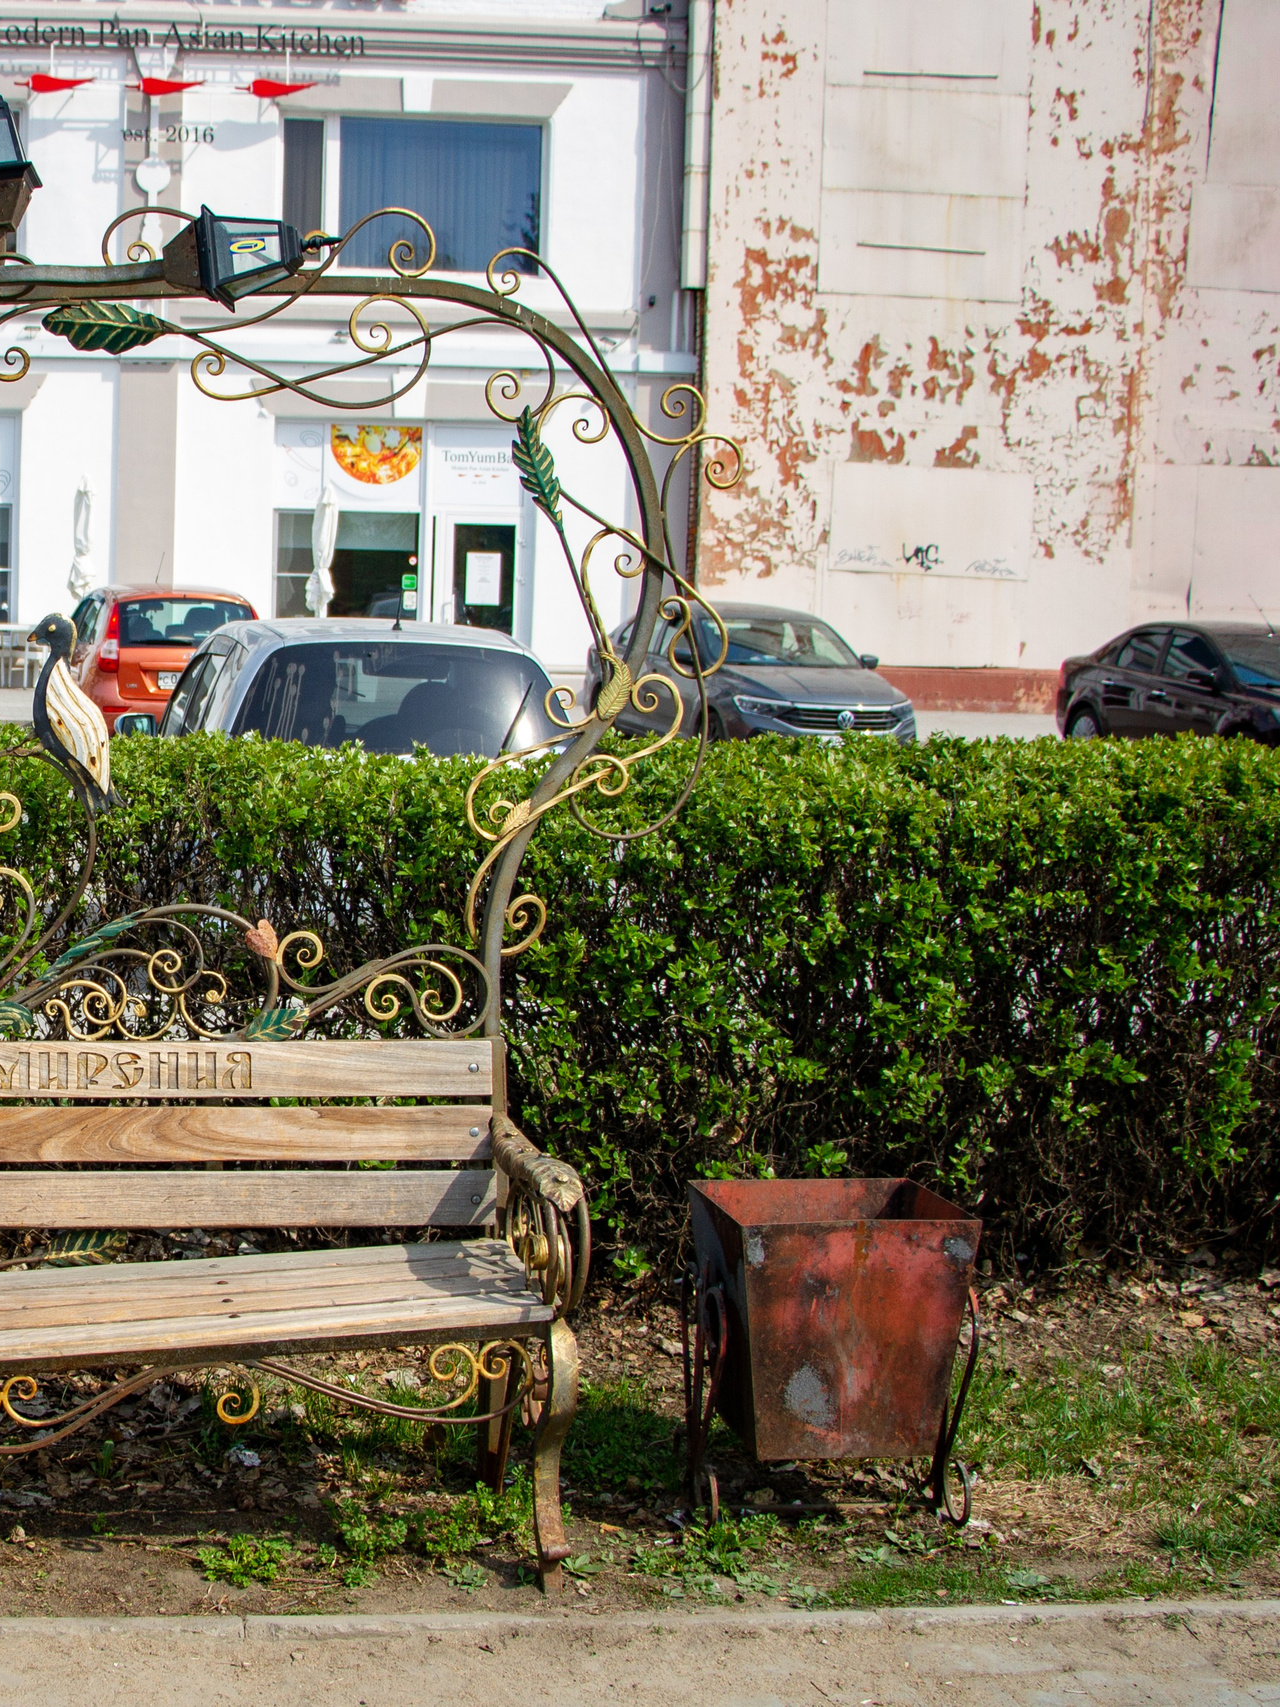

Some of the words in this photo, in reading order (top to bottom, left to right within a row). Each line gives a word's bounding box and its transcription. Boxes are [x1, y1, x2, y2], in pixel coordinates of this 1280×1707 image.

[99, 19, 149, 47] Pan
[163, 22, 245, 50] Asian
[257, 24, 365, 56] Kitchen
[166, 125, 214, 143] 2016
